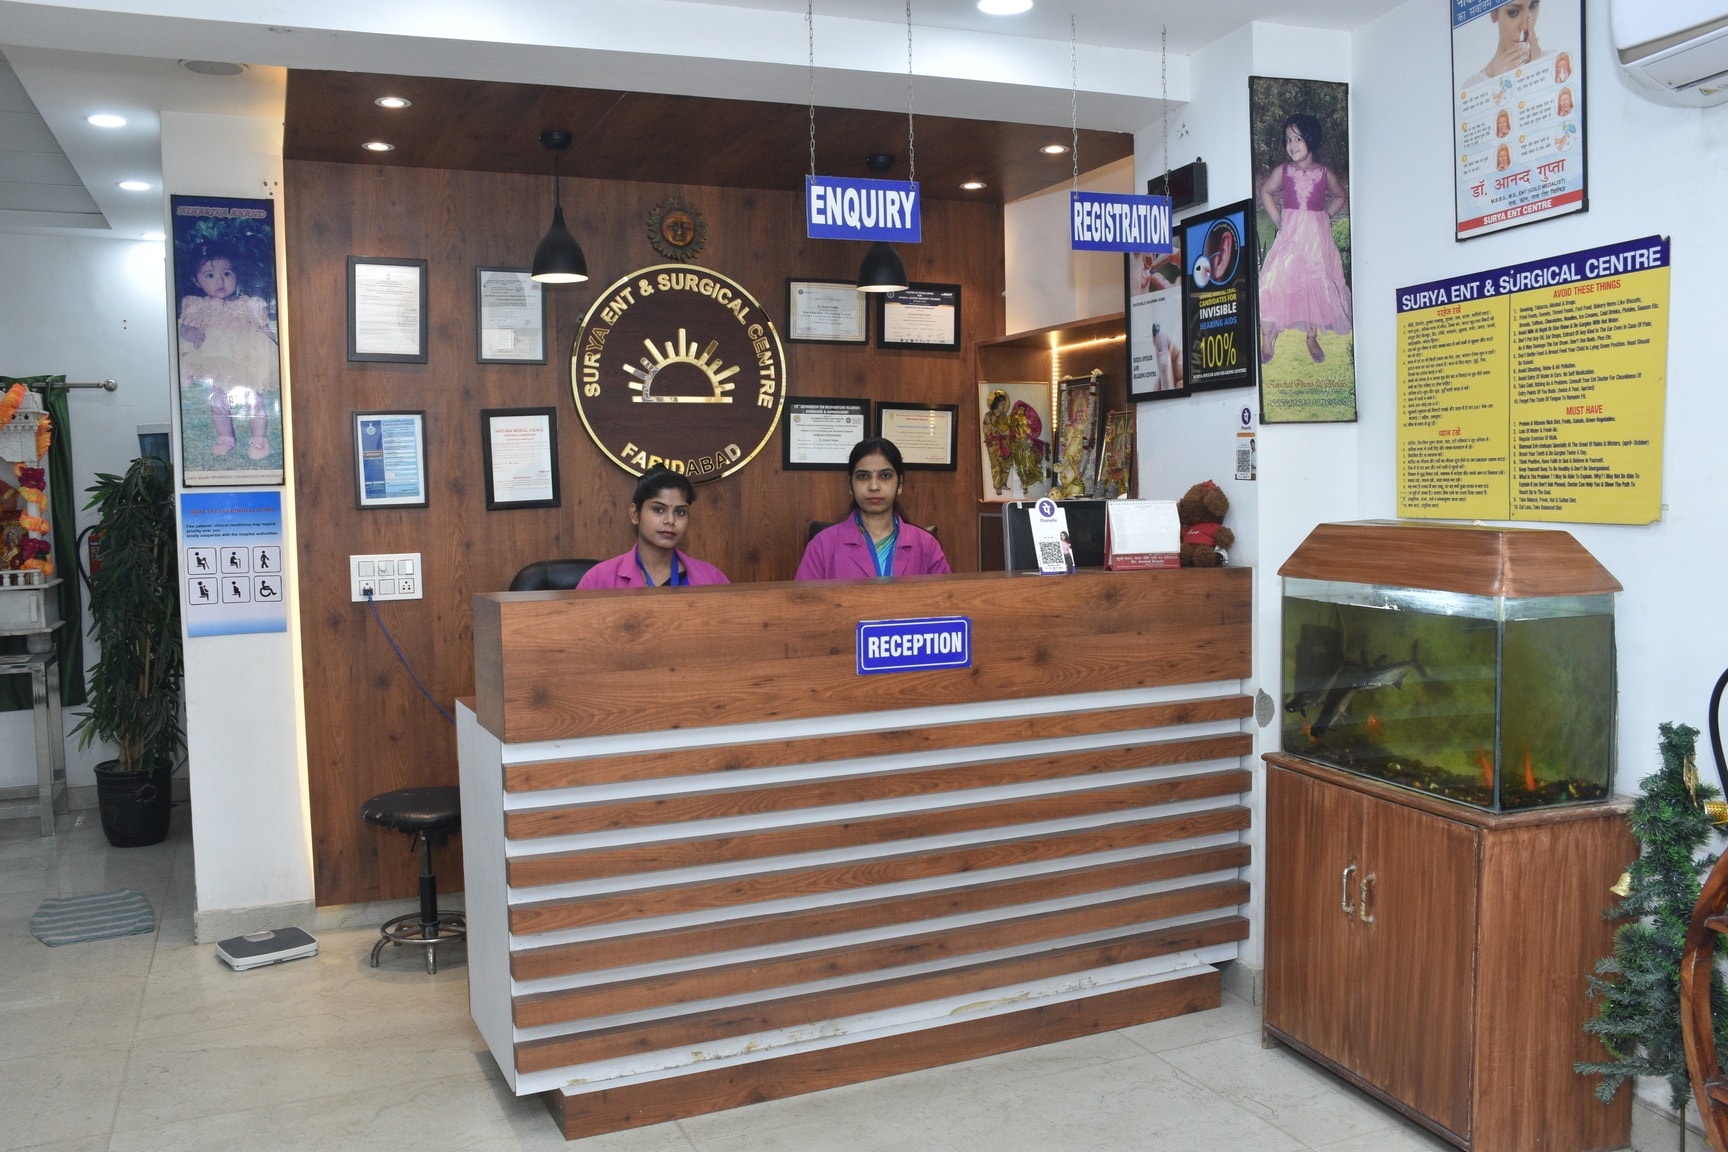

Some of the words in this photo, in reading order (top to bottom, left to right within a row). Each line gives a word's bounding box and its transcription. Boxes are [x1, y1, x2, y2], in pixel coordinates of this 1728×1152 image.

[1471, 180, 1487, 198] डॉ.
[1495, 170, 1531, 190] आनन्द
[1537, 159, 1566, 182] गुप्ता
[811, 185, 916, 230] ENQUIRY
[1484, 212, 1506, 225] SURYA
[1507, 207, 1522, 218] ENT
[1523, 200, 1552, 215] CENTRE
[1074, 202, 1170, 244] REGISTRATION
[1402, 288, 1448, 310] SURYA
[1451, 282, 1480, 302] ENT
[1484, 279, 1496, 296] &
[1500, 263, 1580, 294] SURGICAL
[1586, 246, 1662, 277] CENTRE
[1553, 287, 1572, 298] AVOID
[1574, 283, 1594, 295] THESE
[1596, 278, 1620, 292] THINGS
[1200, 296, 1226, 308] CANDIDATES
[1200, 302, 1237, 320] INVISIBLE
[1200, 320, 1223, 330] HEARING
[1224, 316, 1237, 326] AIDS
[582, 327, 610, 398] SURYA
[600, 287, 636, 326] ENT
[638, 279, 654, 296] &
[657, 272, 752, 325] SURGICAL
[748, 323, 776, 408] CENTRE
[1200, 331, 1237, 368] 100%
[1566, 406, 1584, 415] MUST
[1585, 404, 1602, 414] HAVE
[620, 442, 742, 477] FARIDABAD
[1042, 502, 1051, 516] पे
[868, 632, 962, 658] RECEPTION
